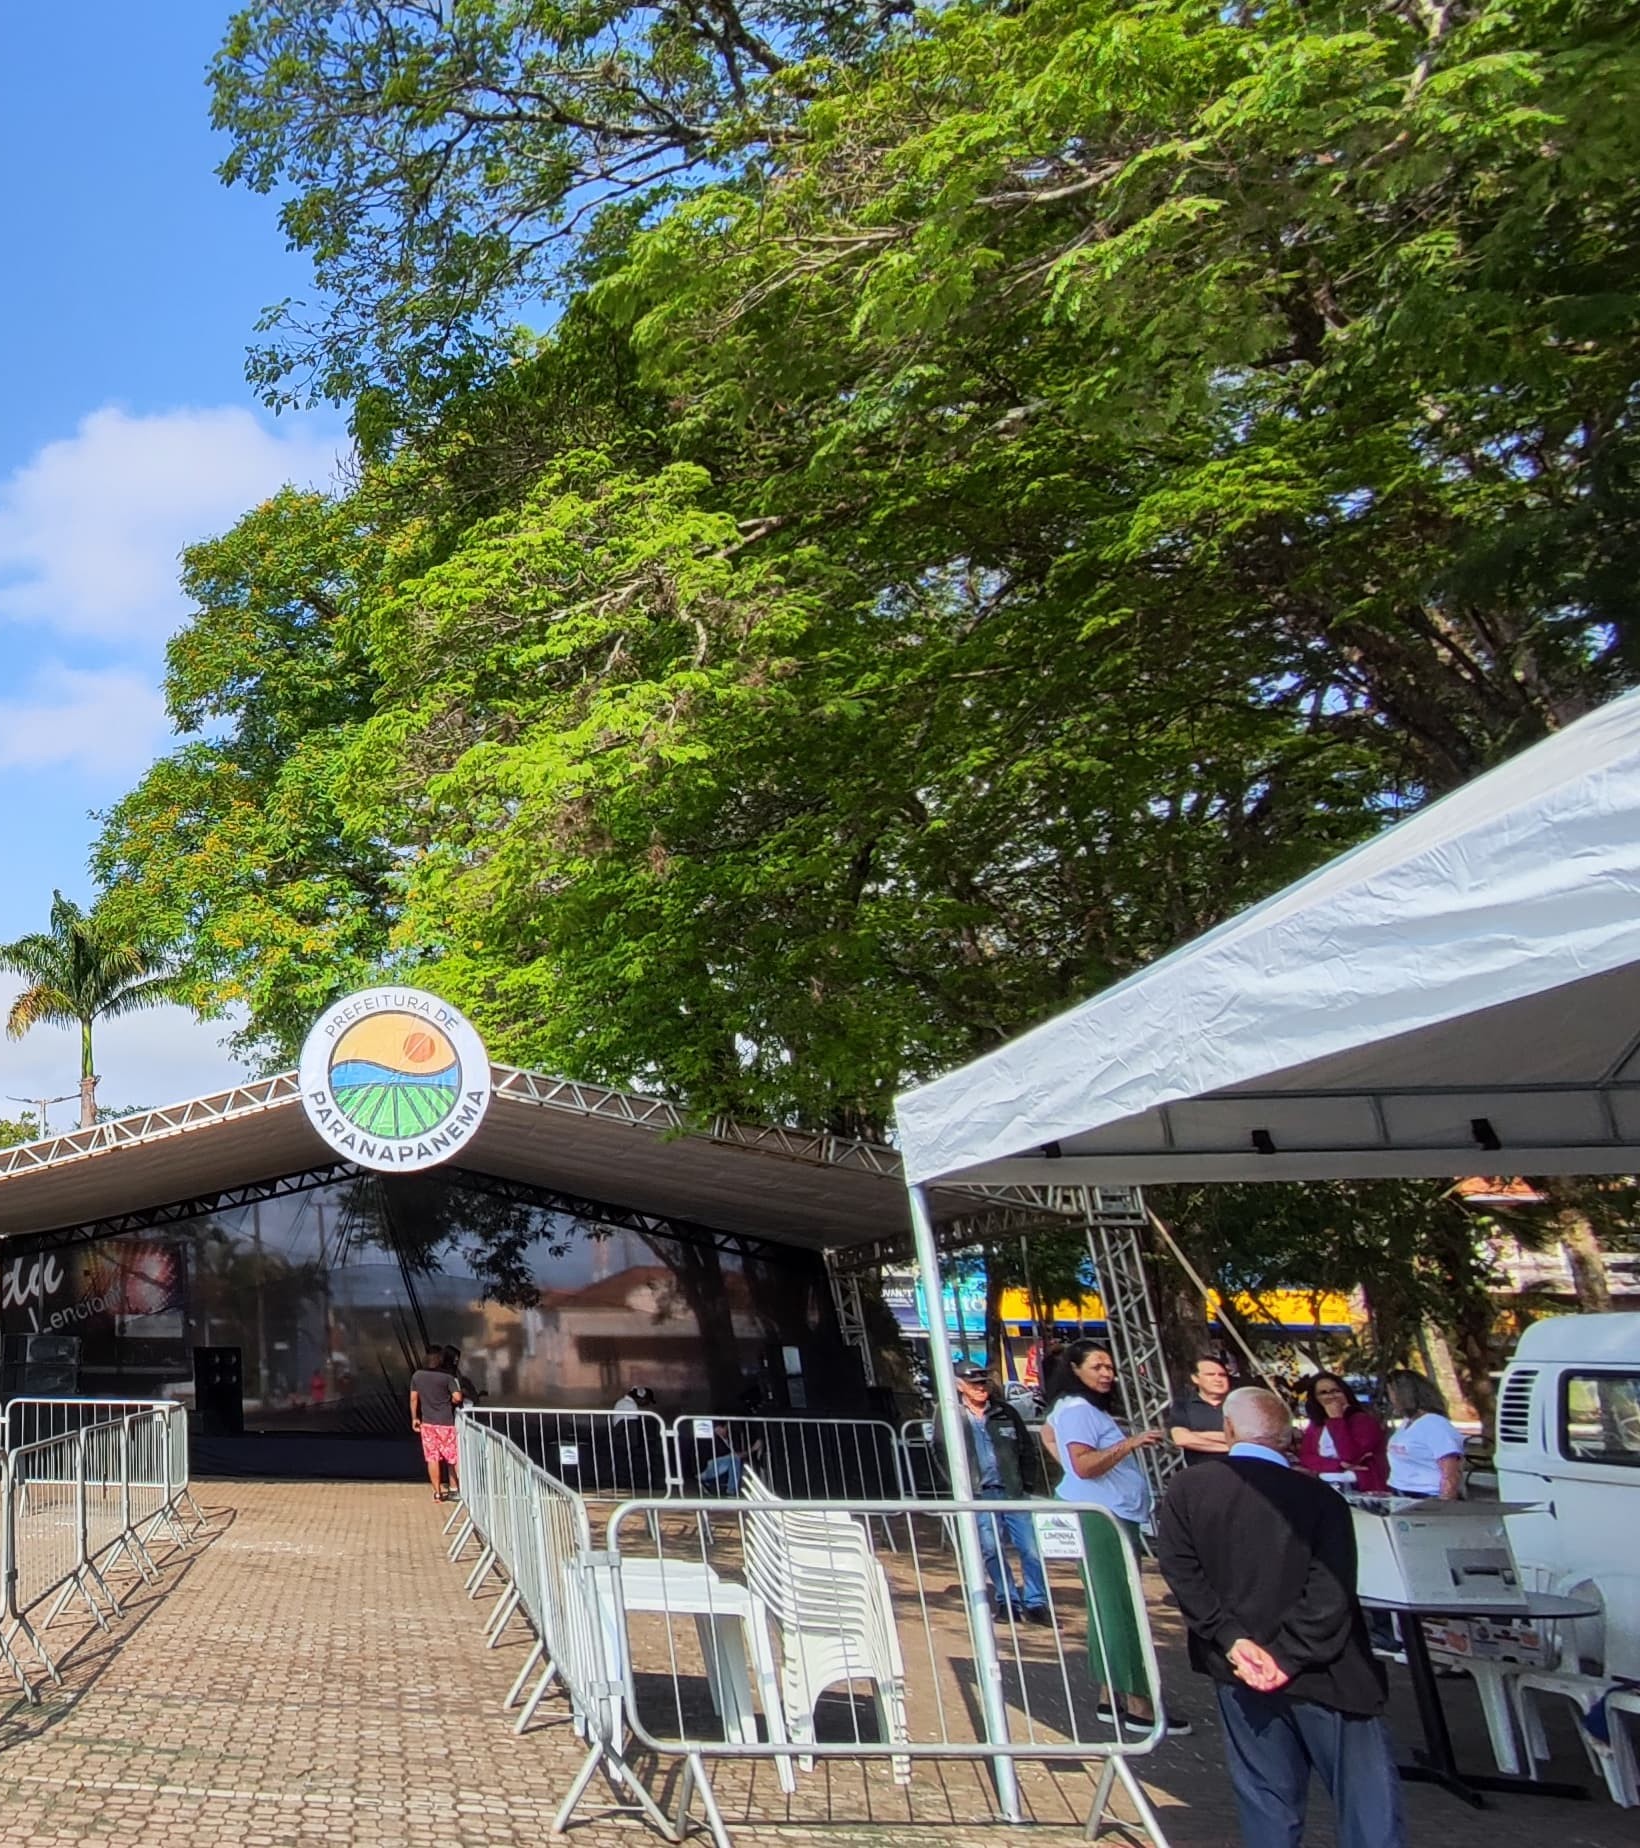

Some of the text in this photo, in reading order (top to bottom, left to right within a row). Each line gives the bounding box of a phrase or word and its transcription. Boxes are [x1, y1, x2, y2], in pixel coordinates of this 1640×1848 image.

[324, 994, 459, 1038] PREFEITURA DE
[309, 1089, 485, 1163] PARANAPANEMA
